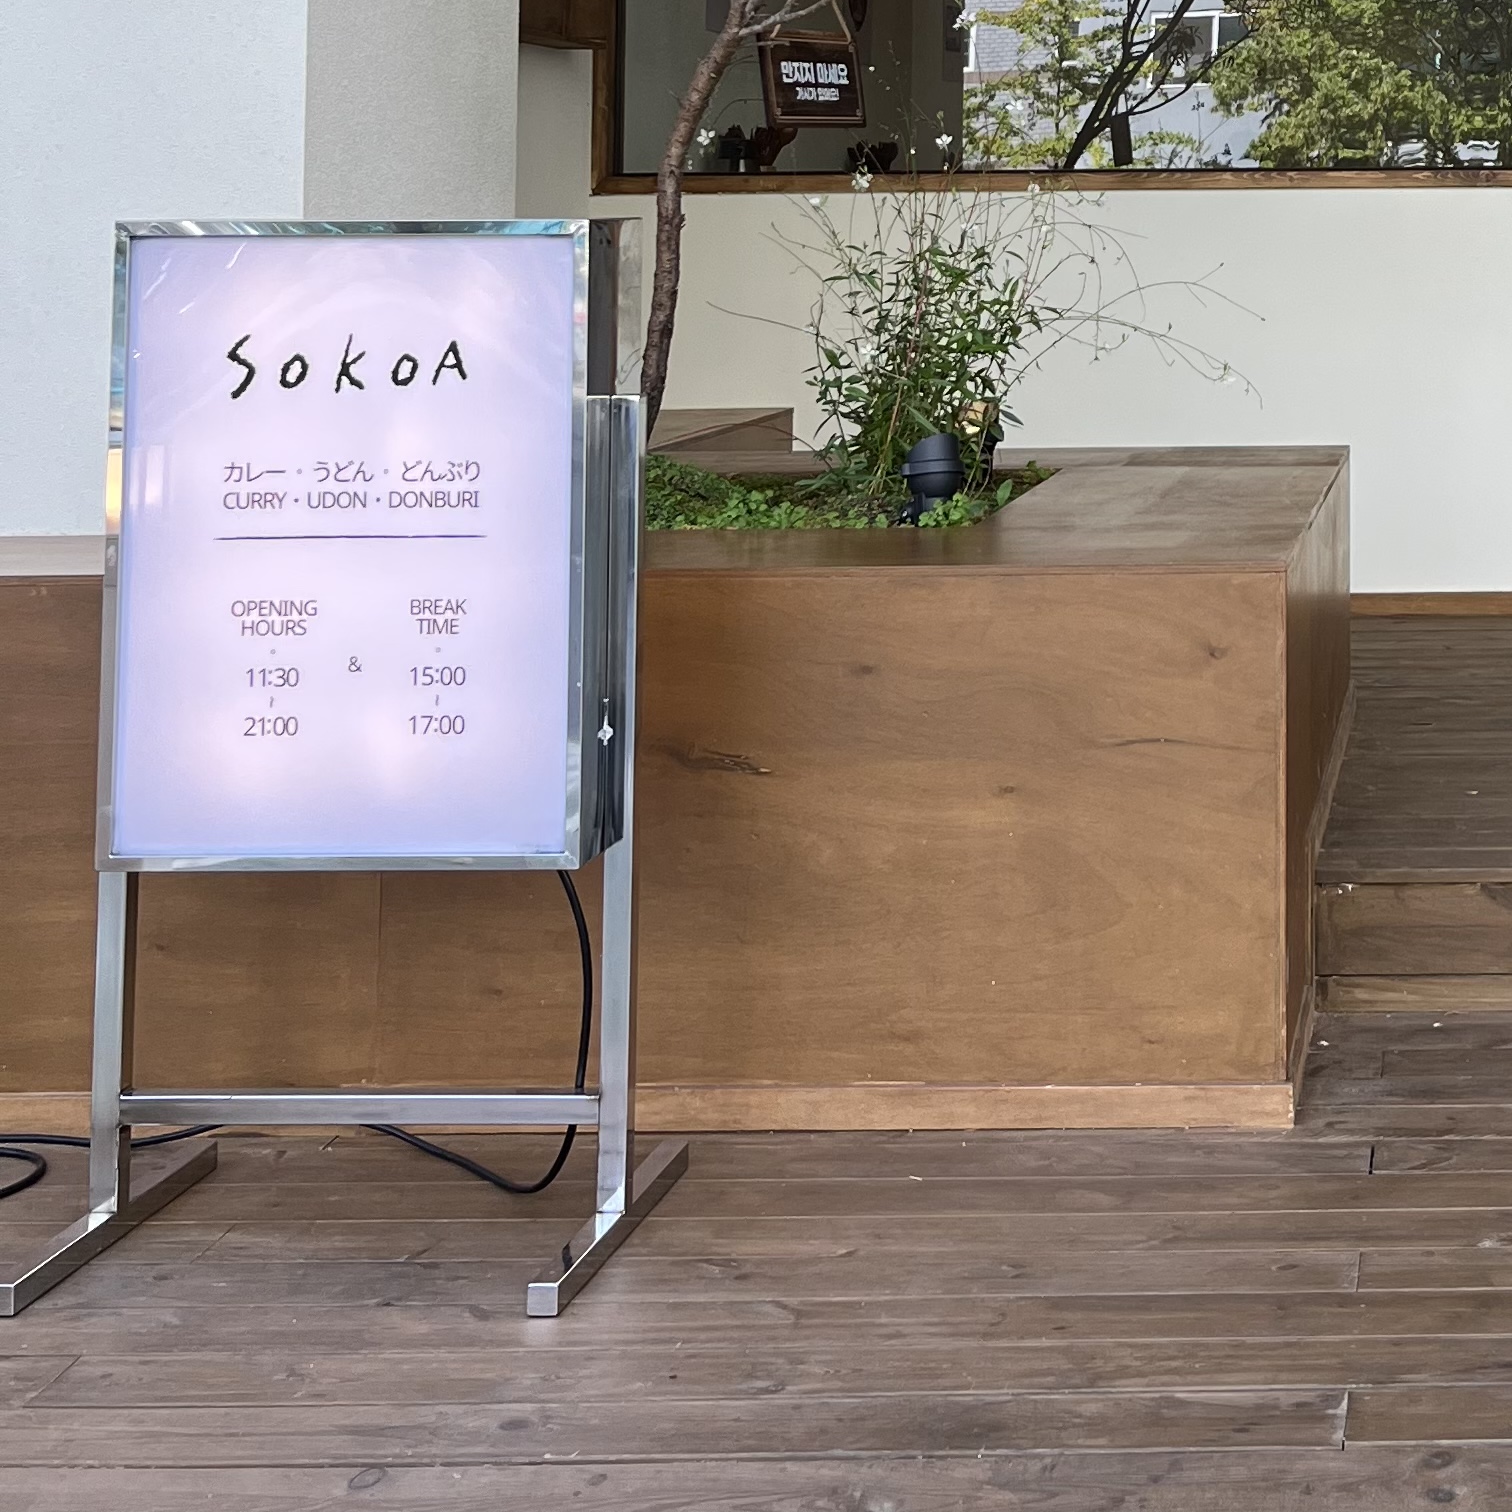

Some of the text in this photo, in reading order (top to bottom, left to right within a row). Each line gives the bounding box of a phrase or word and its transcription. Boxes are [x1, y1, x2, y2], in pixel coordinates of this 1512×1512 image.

[314, 461, 375, 483] うどん
[401, 460, 482, 484] どんぶり
[223, 490, 481, 511] CURRY UDON DONBURI
[231, 599, 318, 619] OPENING
[410, 599, 467, 617] BREAK
[241, 619, 308, 638] HOURS
[416, 619, 460, 636] TIME
[348, 656, 363, 674] &
[245, 667, 301, 689] 11:30
[410, 666, 467, 688] 15:00
[243, 716, 299, 738] 21:00
[409, 715, 466, 737] 17:00
